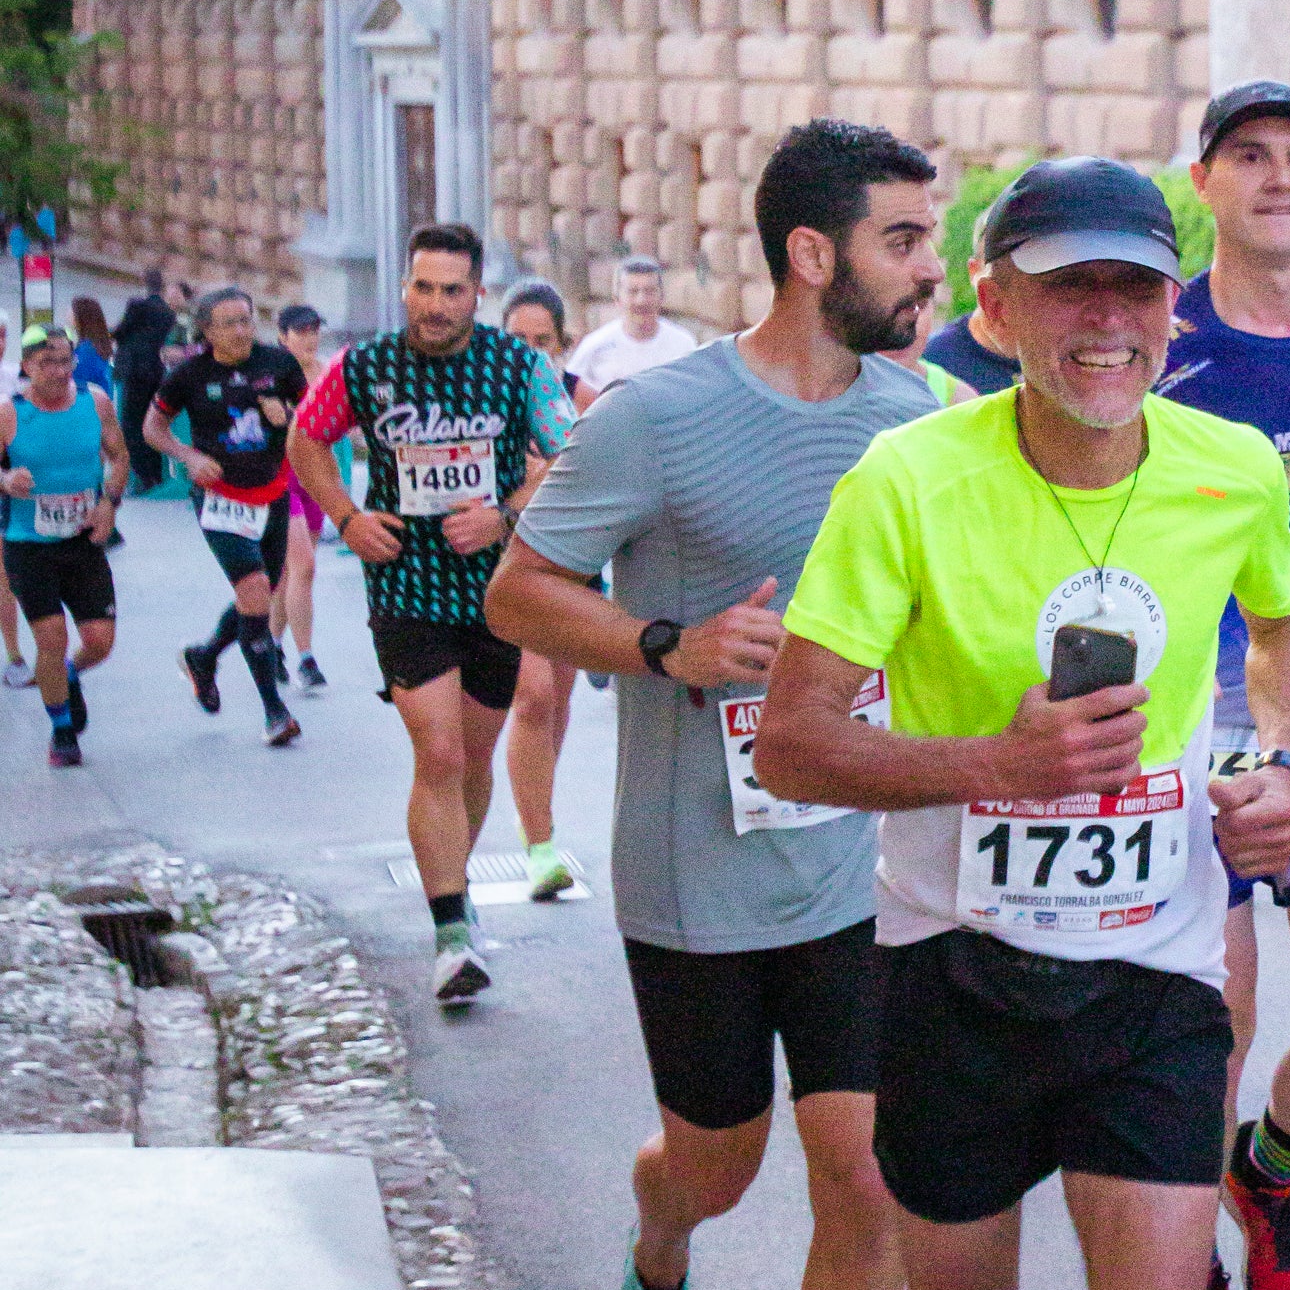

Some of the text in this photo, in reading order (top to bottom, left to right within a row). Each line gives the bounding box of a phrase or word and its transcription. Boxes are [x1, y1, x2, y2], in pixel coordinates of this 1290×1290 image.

[374, 403, 506, 450] Balance
[405, 463, 481, 492] 1480
[1043, 601, 1062, 634] LOS
[1119, 575, 1161, 623] BIRRAS
[1123, 796, 1146, 813] MAYO
[1147, 794, 1167, 810] 2024
[977, 819, 1154, 889] 1731
[1000, 890, 1144, 908] FRANCISCO TORRALBA GONZALEZ
